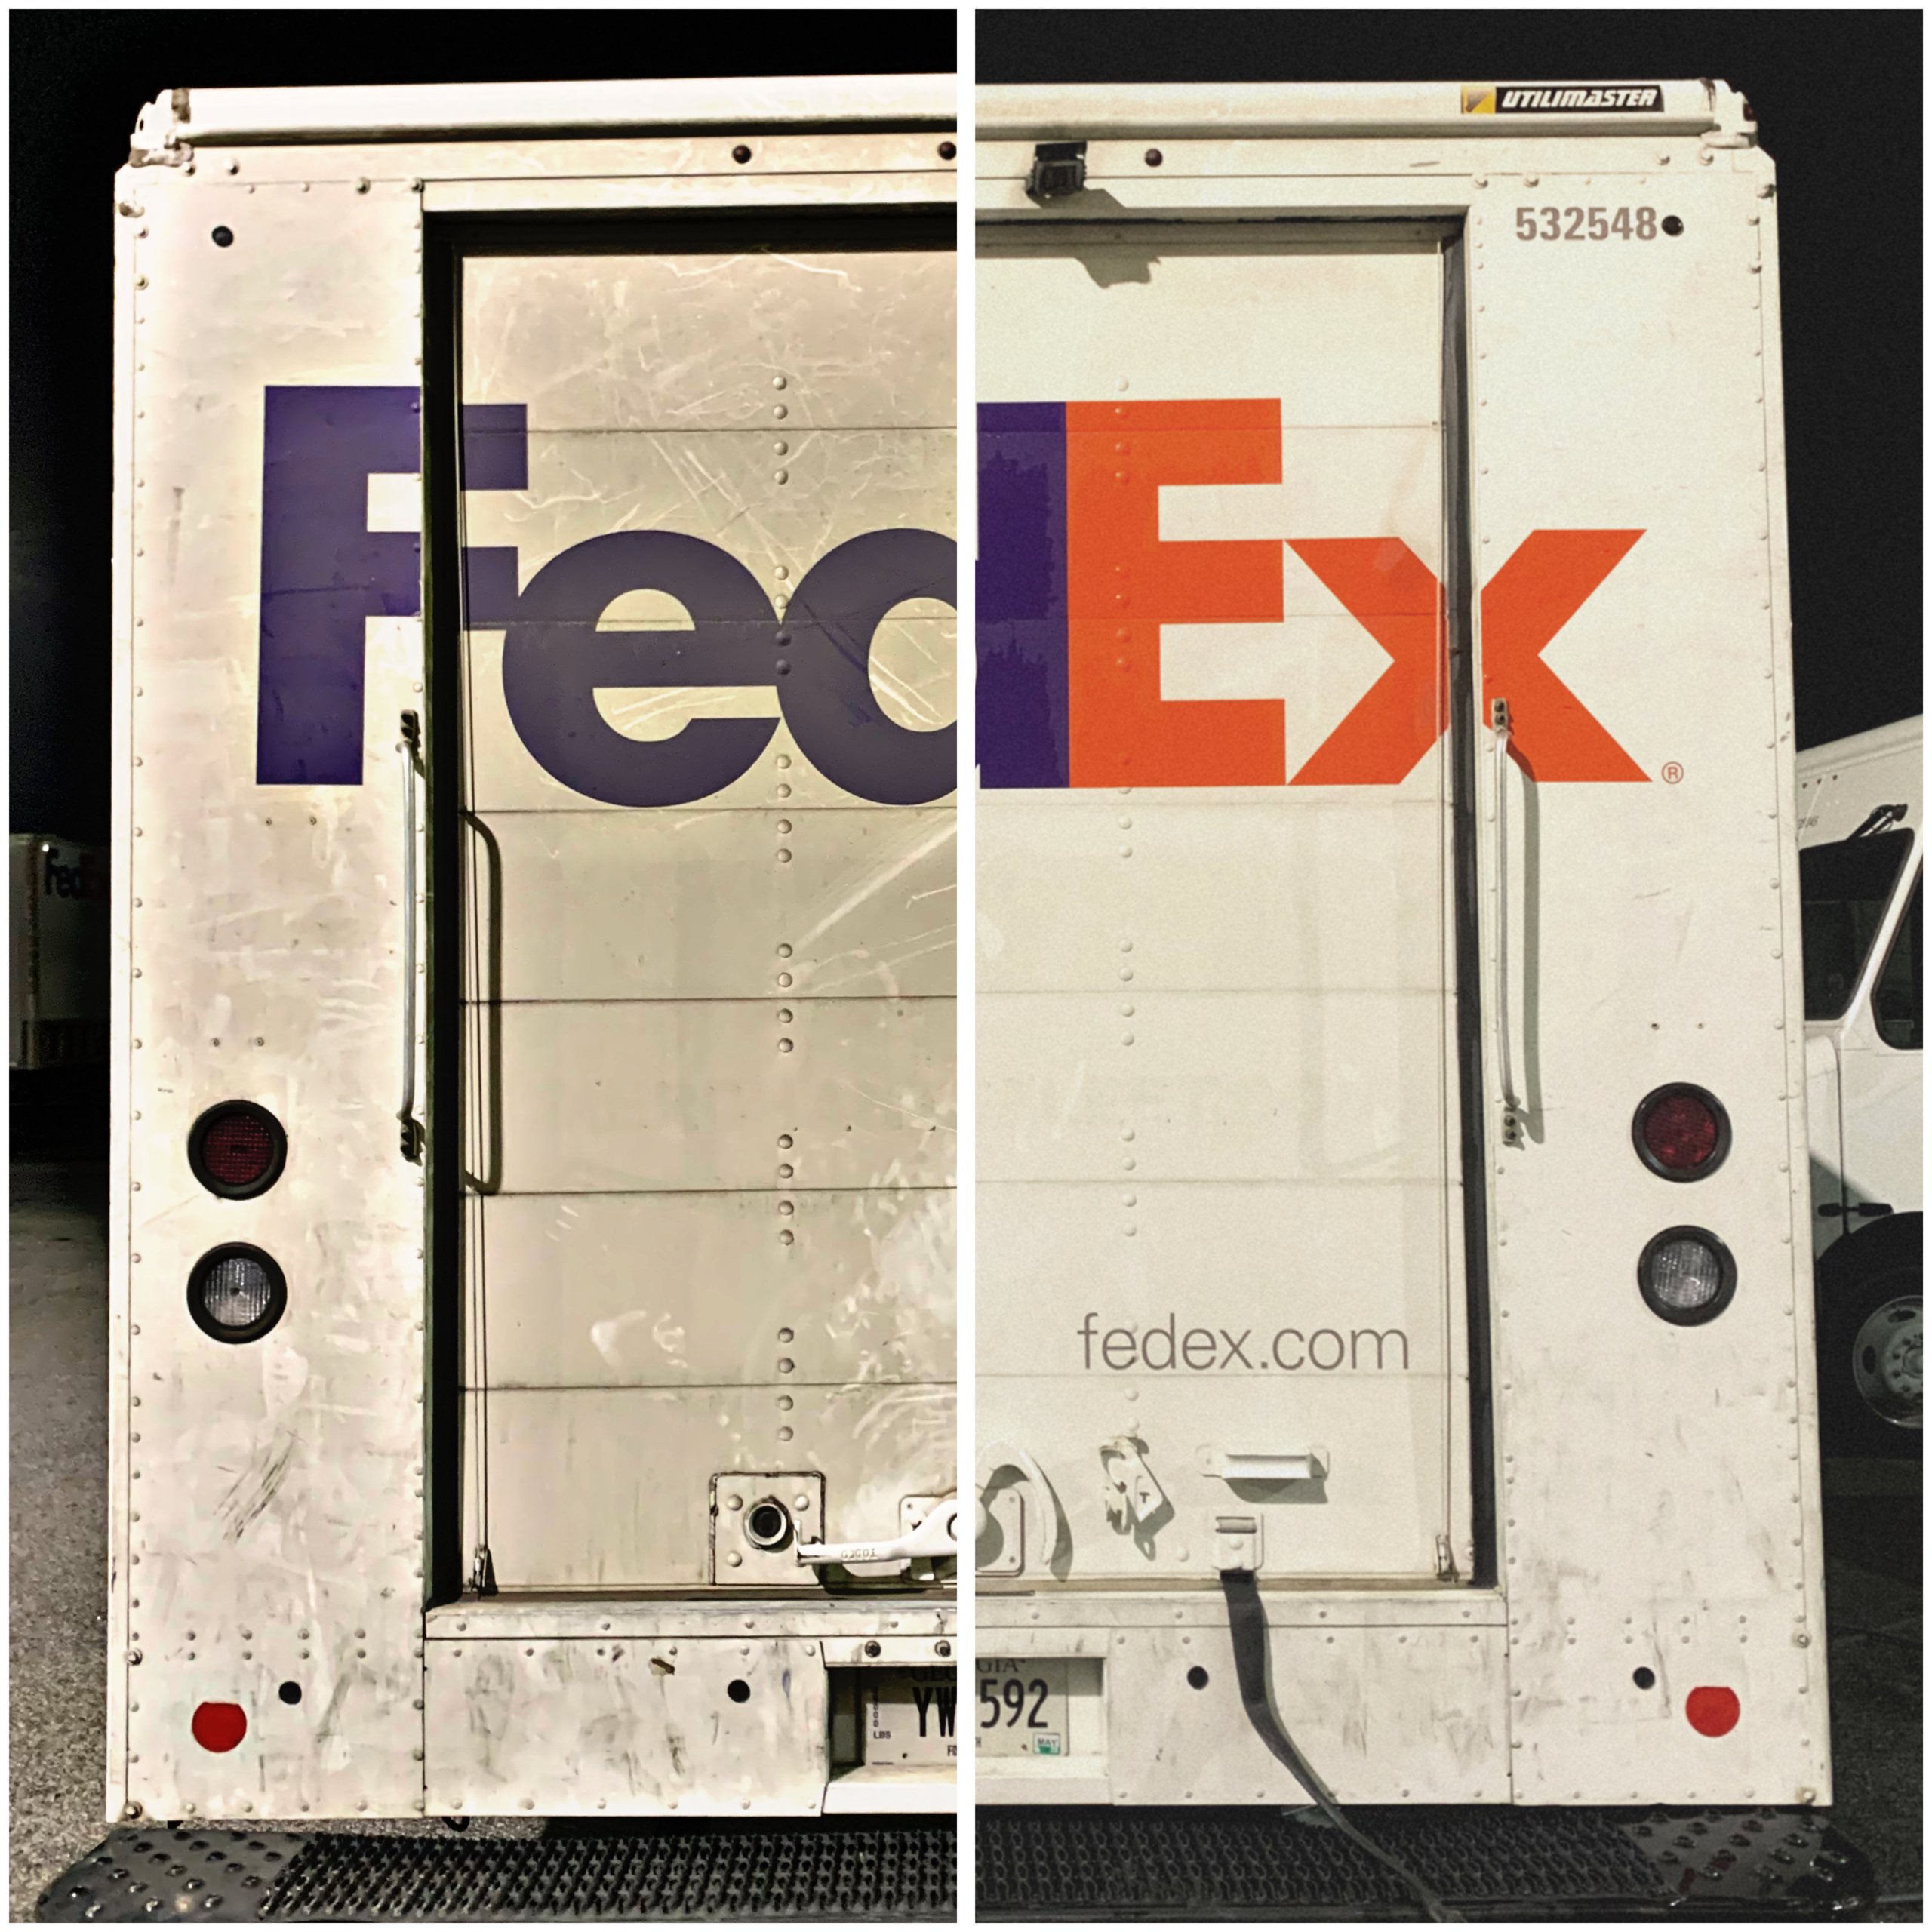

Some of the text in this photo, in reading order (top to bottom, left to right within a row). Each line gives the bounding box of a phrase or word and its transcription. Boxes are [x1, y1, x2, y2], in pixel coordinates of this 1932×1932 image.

[1501, 88, 1658, 108] UTILIMASTER
[1515, 206, 1658, 241] 532548
[1076, 1312, 1410, 1371] fedex.com
[1037, 1738, 1057, 1746] MAY
